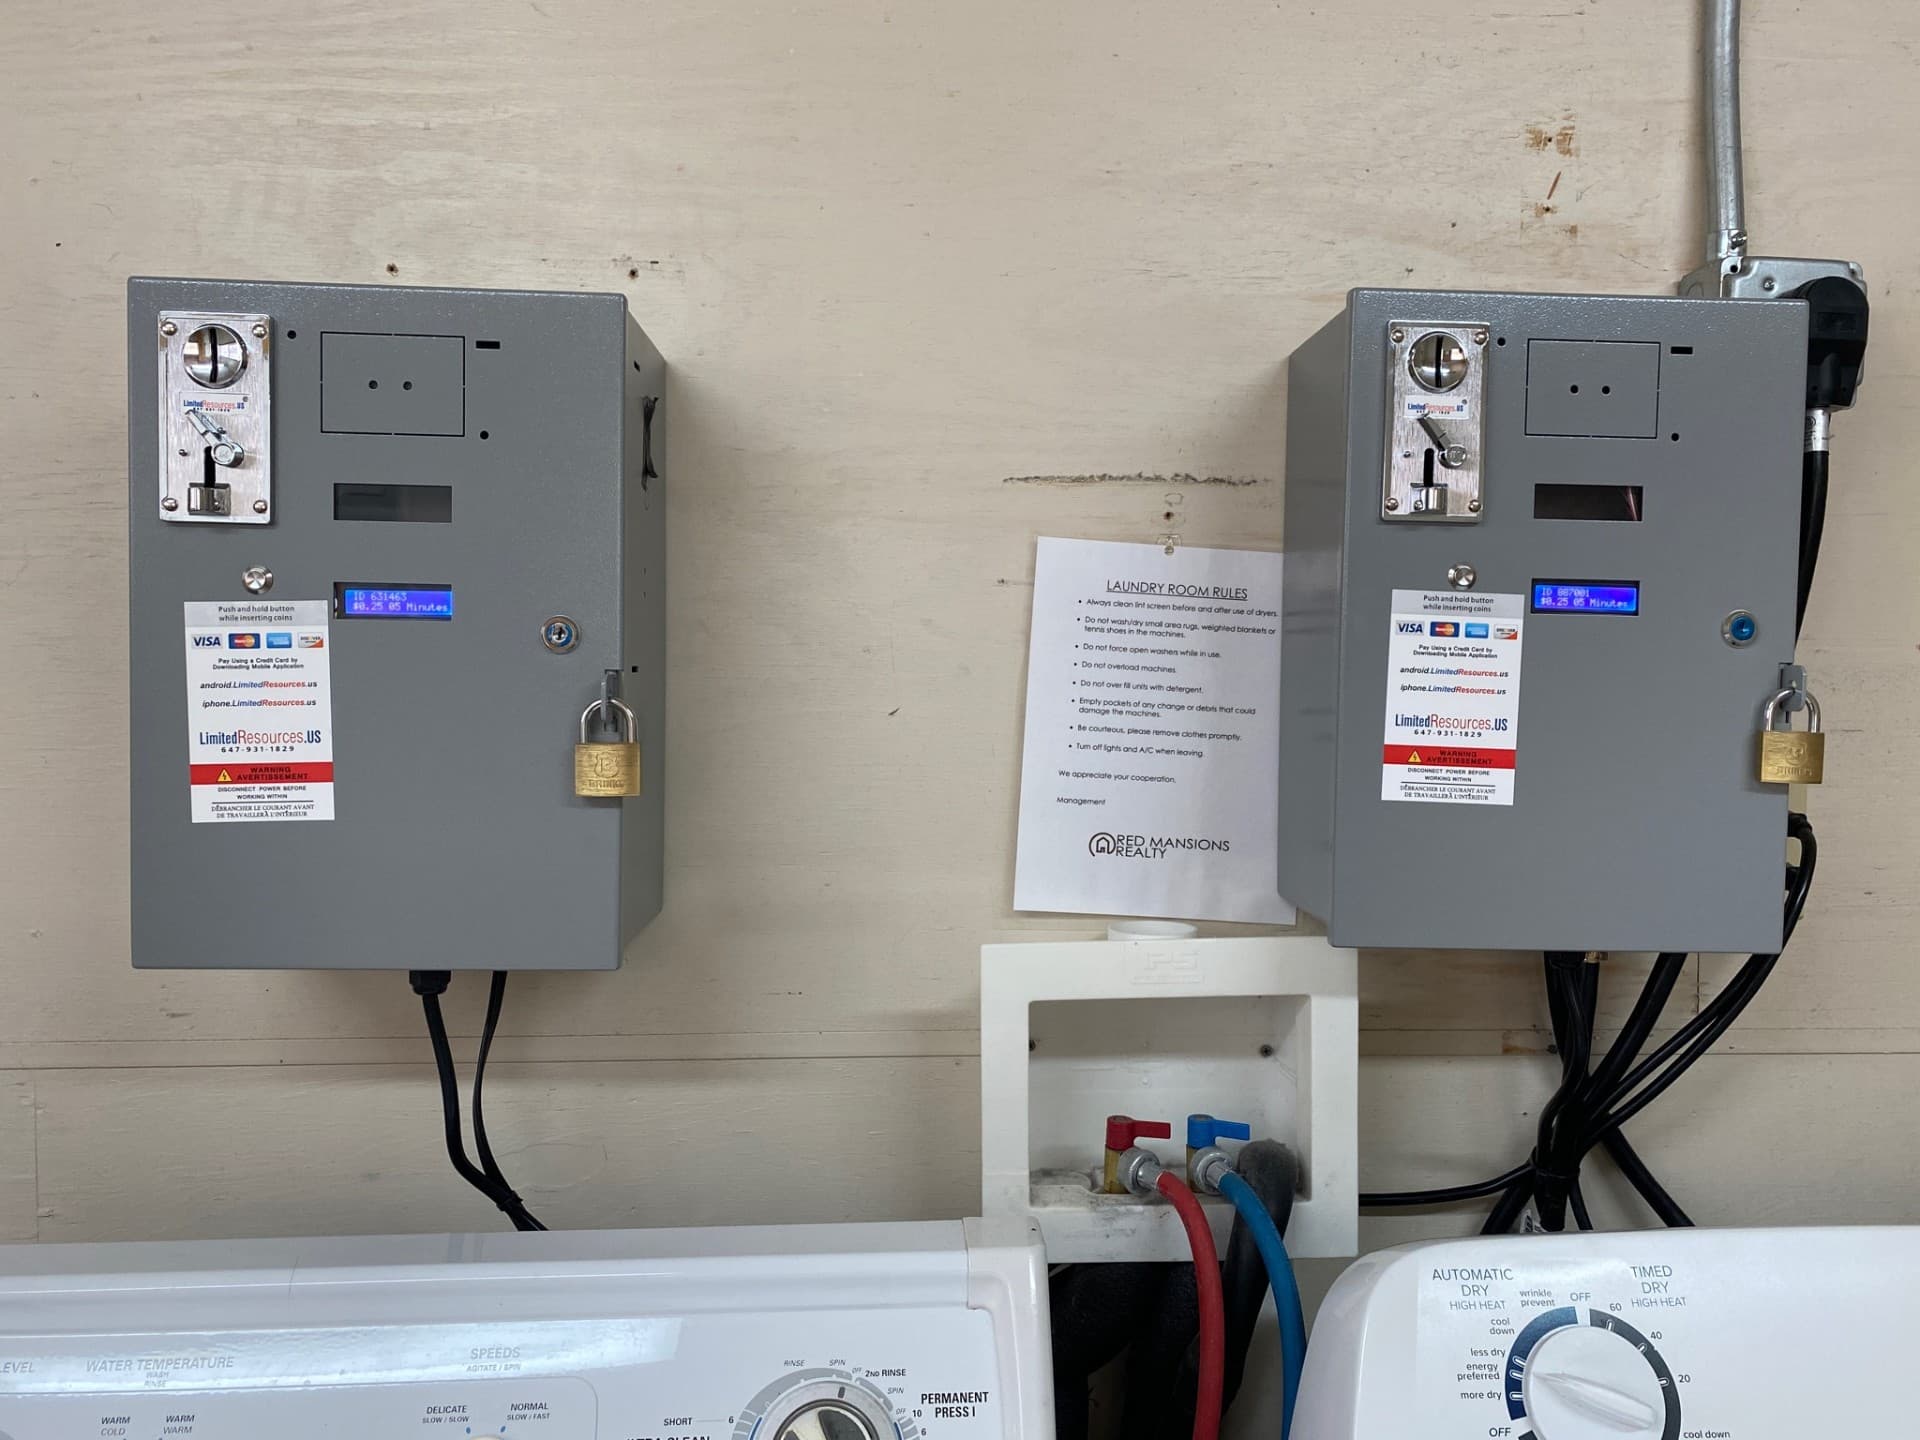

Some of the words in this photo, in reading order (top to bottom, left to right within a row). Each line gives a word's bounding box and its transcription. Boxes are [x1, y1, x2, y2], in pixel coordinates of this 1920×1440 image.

[1106, 580, 1165, 594] LAUNDRY
[1168, 583, 1210, 596] ROOM
[1212, 587, 1248, 600] RULES
[354, 592, 365, 600] ID
[370, 592, 407, 601] 631463
[353, 602, 384, 611] $0.25
[388, 602, 400, 611] 05
[406, 602, 448, 612] Minutes
[1590, 598, 1628, 608] Minutes
[1084, 615, 1095, 624] Do
[1398, 623, 1423, 633] VISA
[194, 636, 221, 646] VISA
[1400, 666, 1509, 678] android.LimitedResources.us
[200, 680, 318, 689] android.LimitedResources.us
[1165, 685, 1203, 694] detergent.
[1400, 684, 1506, 695] iphone.LimitedResources.us
[202, 700, 316, 708] iphone.LimitedResources.us
[1079, 697, 1101, 705] Empty
[1078, 707, 1110, 715] damage
[1396, 714, 1508, 731] LimitedResources.US
[200, 730, 321, 745] LimitedResources.US
[1103, 744, 1121, 752] lights
[1176, 750, 1205, 758] leaving.
[1057, 796, 1106, 806] Management
[1116, 834, 1144, 846] RED
[1150, 837, 1230, 852] MANSIONS
[1116, 846, 1166, 858] REALTY
[1432, 1268, 1514, 1281] AUTOMATIC
[1630, 1265, 1673, 1278] TIMED
[1462, 1284, 1489, 1296] DRY
[1520, 1289, 1552, 1297] wrinkle
[1641, 1282, 1668, 1294] DRY
[1570, 1292, 1591, 1301] OFF
[1450, 1300, 1476, 1310] HIGH
[1480, 1300, 1506, 1310] HEAT
[1610, 1303, 1622, 1312] 60
[1632, 1298, 1658, 1308] HIGH
[1661, 1297, 1686, 1306] HEAT
[1490, 1327, 1514, 1335] down
[1650, 1331, 1662, 1340] 40
[470, 1347, 520, 1360] SPEEDS
[1490, 1348, 1506, 1358] dry
[86, 1360, 133, 1373] WATER
[137, 1356, 235, 1371] TEMPERATURE
[1466, 1364, 1498, 1372] energy
[1457, 1372, 1500, 1382] preferred
[1678, 1374, 1691, 1383] 20
[921, 1392, 989, 1404] PERMANENT
[1487, 1391, 1502, 1400] dry
[426, 1405, 467, 1414] DELICATE
[510, 1402, 549, 1412] NORMAL
[935, 1406, 969, 1418] PRESS
[972, 1406, 975, 1417] I
[664, 1417, 692, 1426] SHORT
[101, 1428, 126, 1436] COLD
[163, 1426, 193, 1434] WARM
[1489, 1428, 1511, 1437] OFF
[1683, 1430, 1702, 1439] cool
[1705, 1430, 1730, 1438] down
